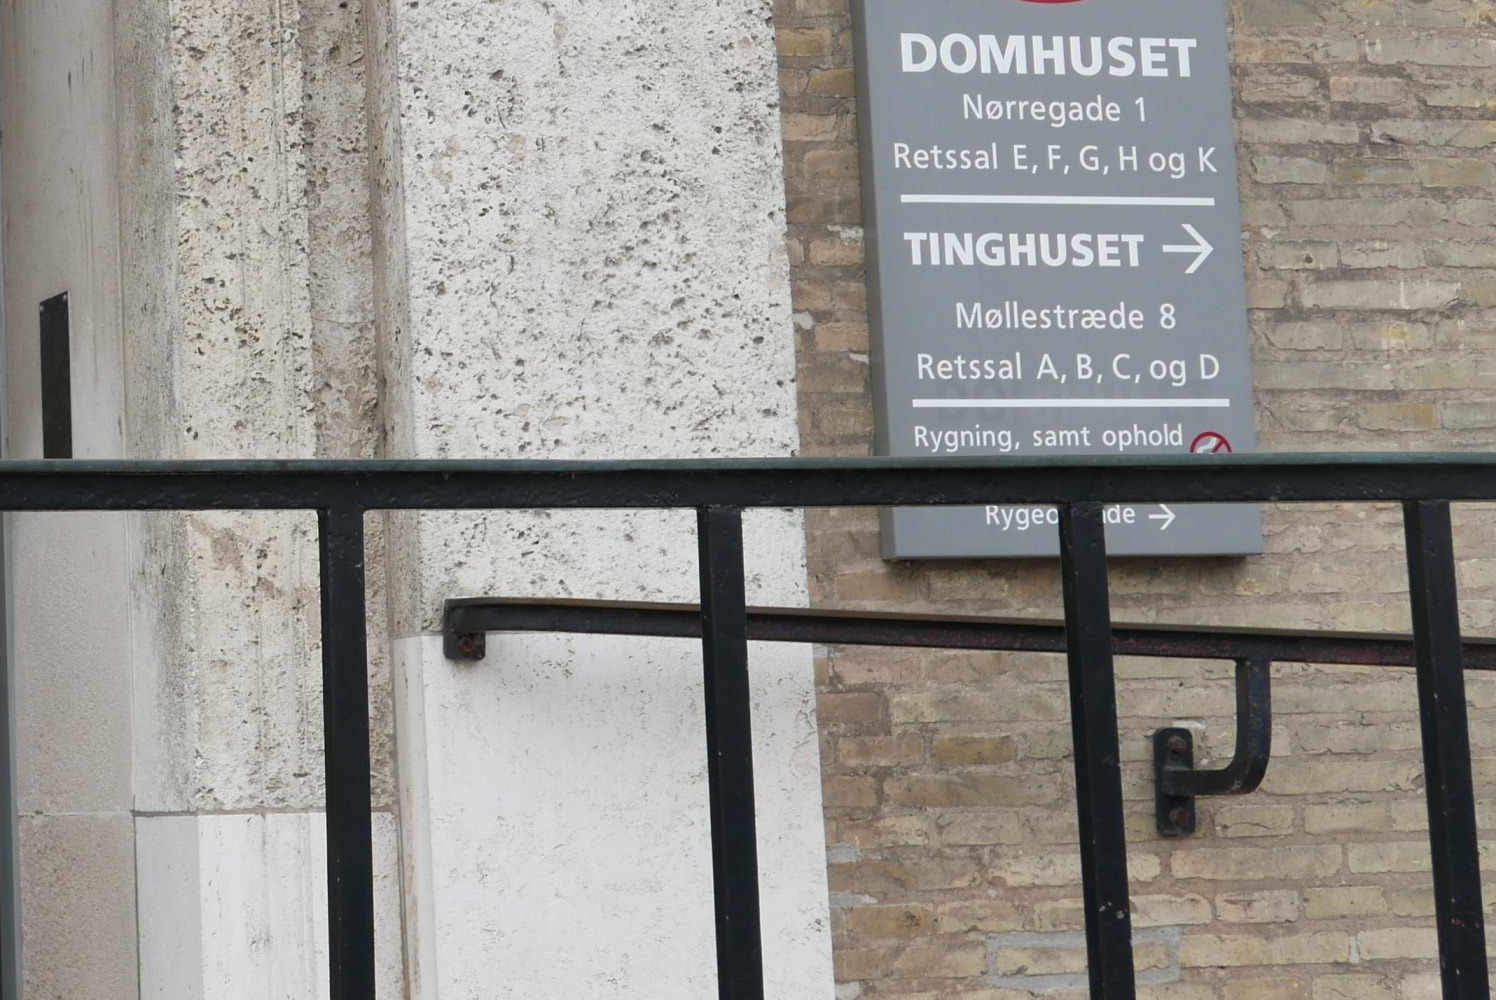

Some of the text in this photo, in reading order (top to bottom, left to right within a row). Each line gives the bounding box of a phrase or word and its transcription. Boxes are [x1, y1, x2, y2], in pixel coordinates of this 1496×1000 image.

[900, 32, 1198, 78] DOMHUSET
[962, 93, 1146, 128] Nørregade 1
[893, 142, 1218, 179] Retssal E, F, G, H og K
[903, 231, 1145, 268] TINGHUSET
[955, 300, 1176, 330] Møllestræde 8
[917, 351, 1220, 387] Retssal A, B, C, og D
[914, 423, 1183, 453] Rygning, samt ophold
